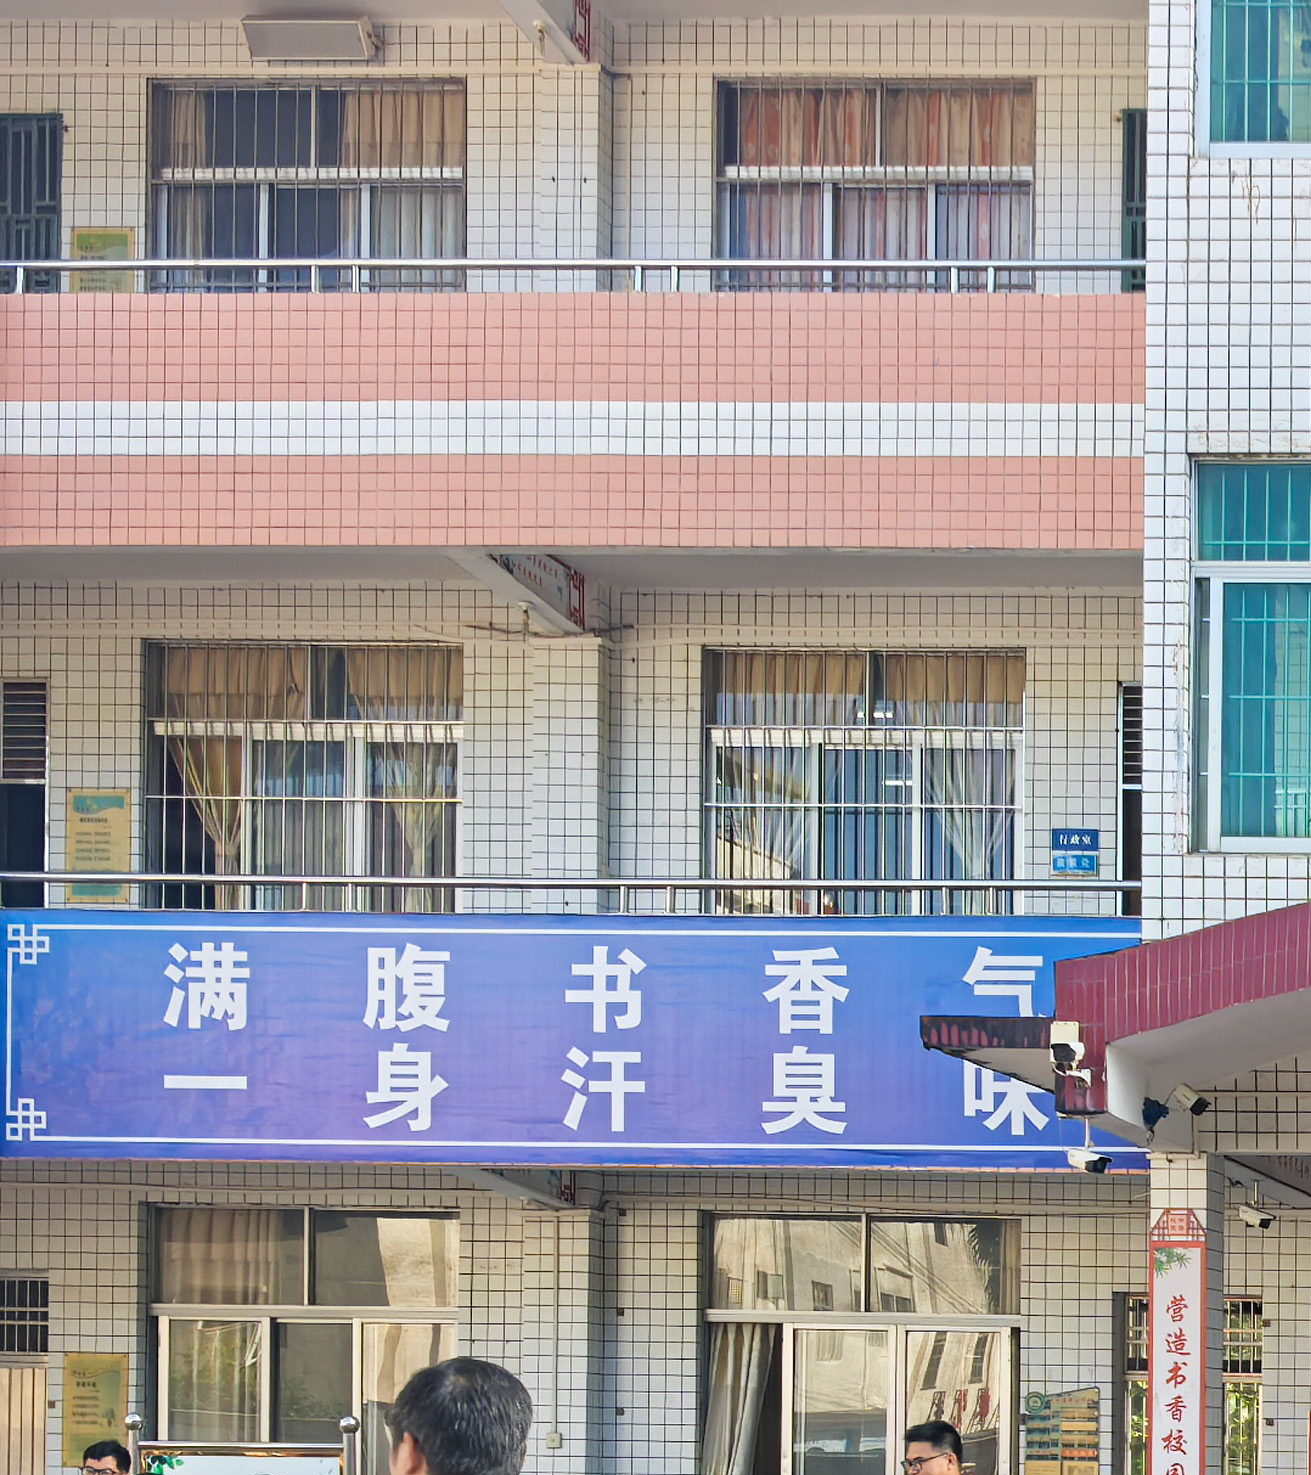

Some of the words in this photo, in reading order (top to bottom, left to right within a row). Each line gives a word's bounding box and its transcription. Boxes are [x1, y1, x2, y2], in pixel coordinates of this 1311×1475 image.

[164, 941, 1044, 1032] 满腹书香气
[164, 1042, 1050, 1136] 一身汗臭味
